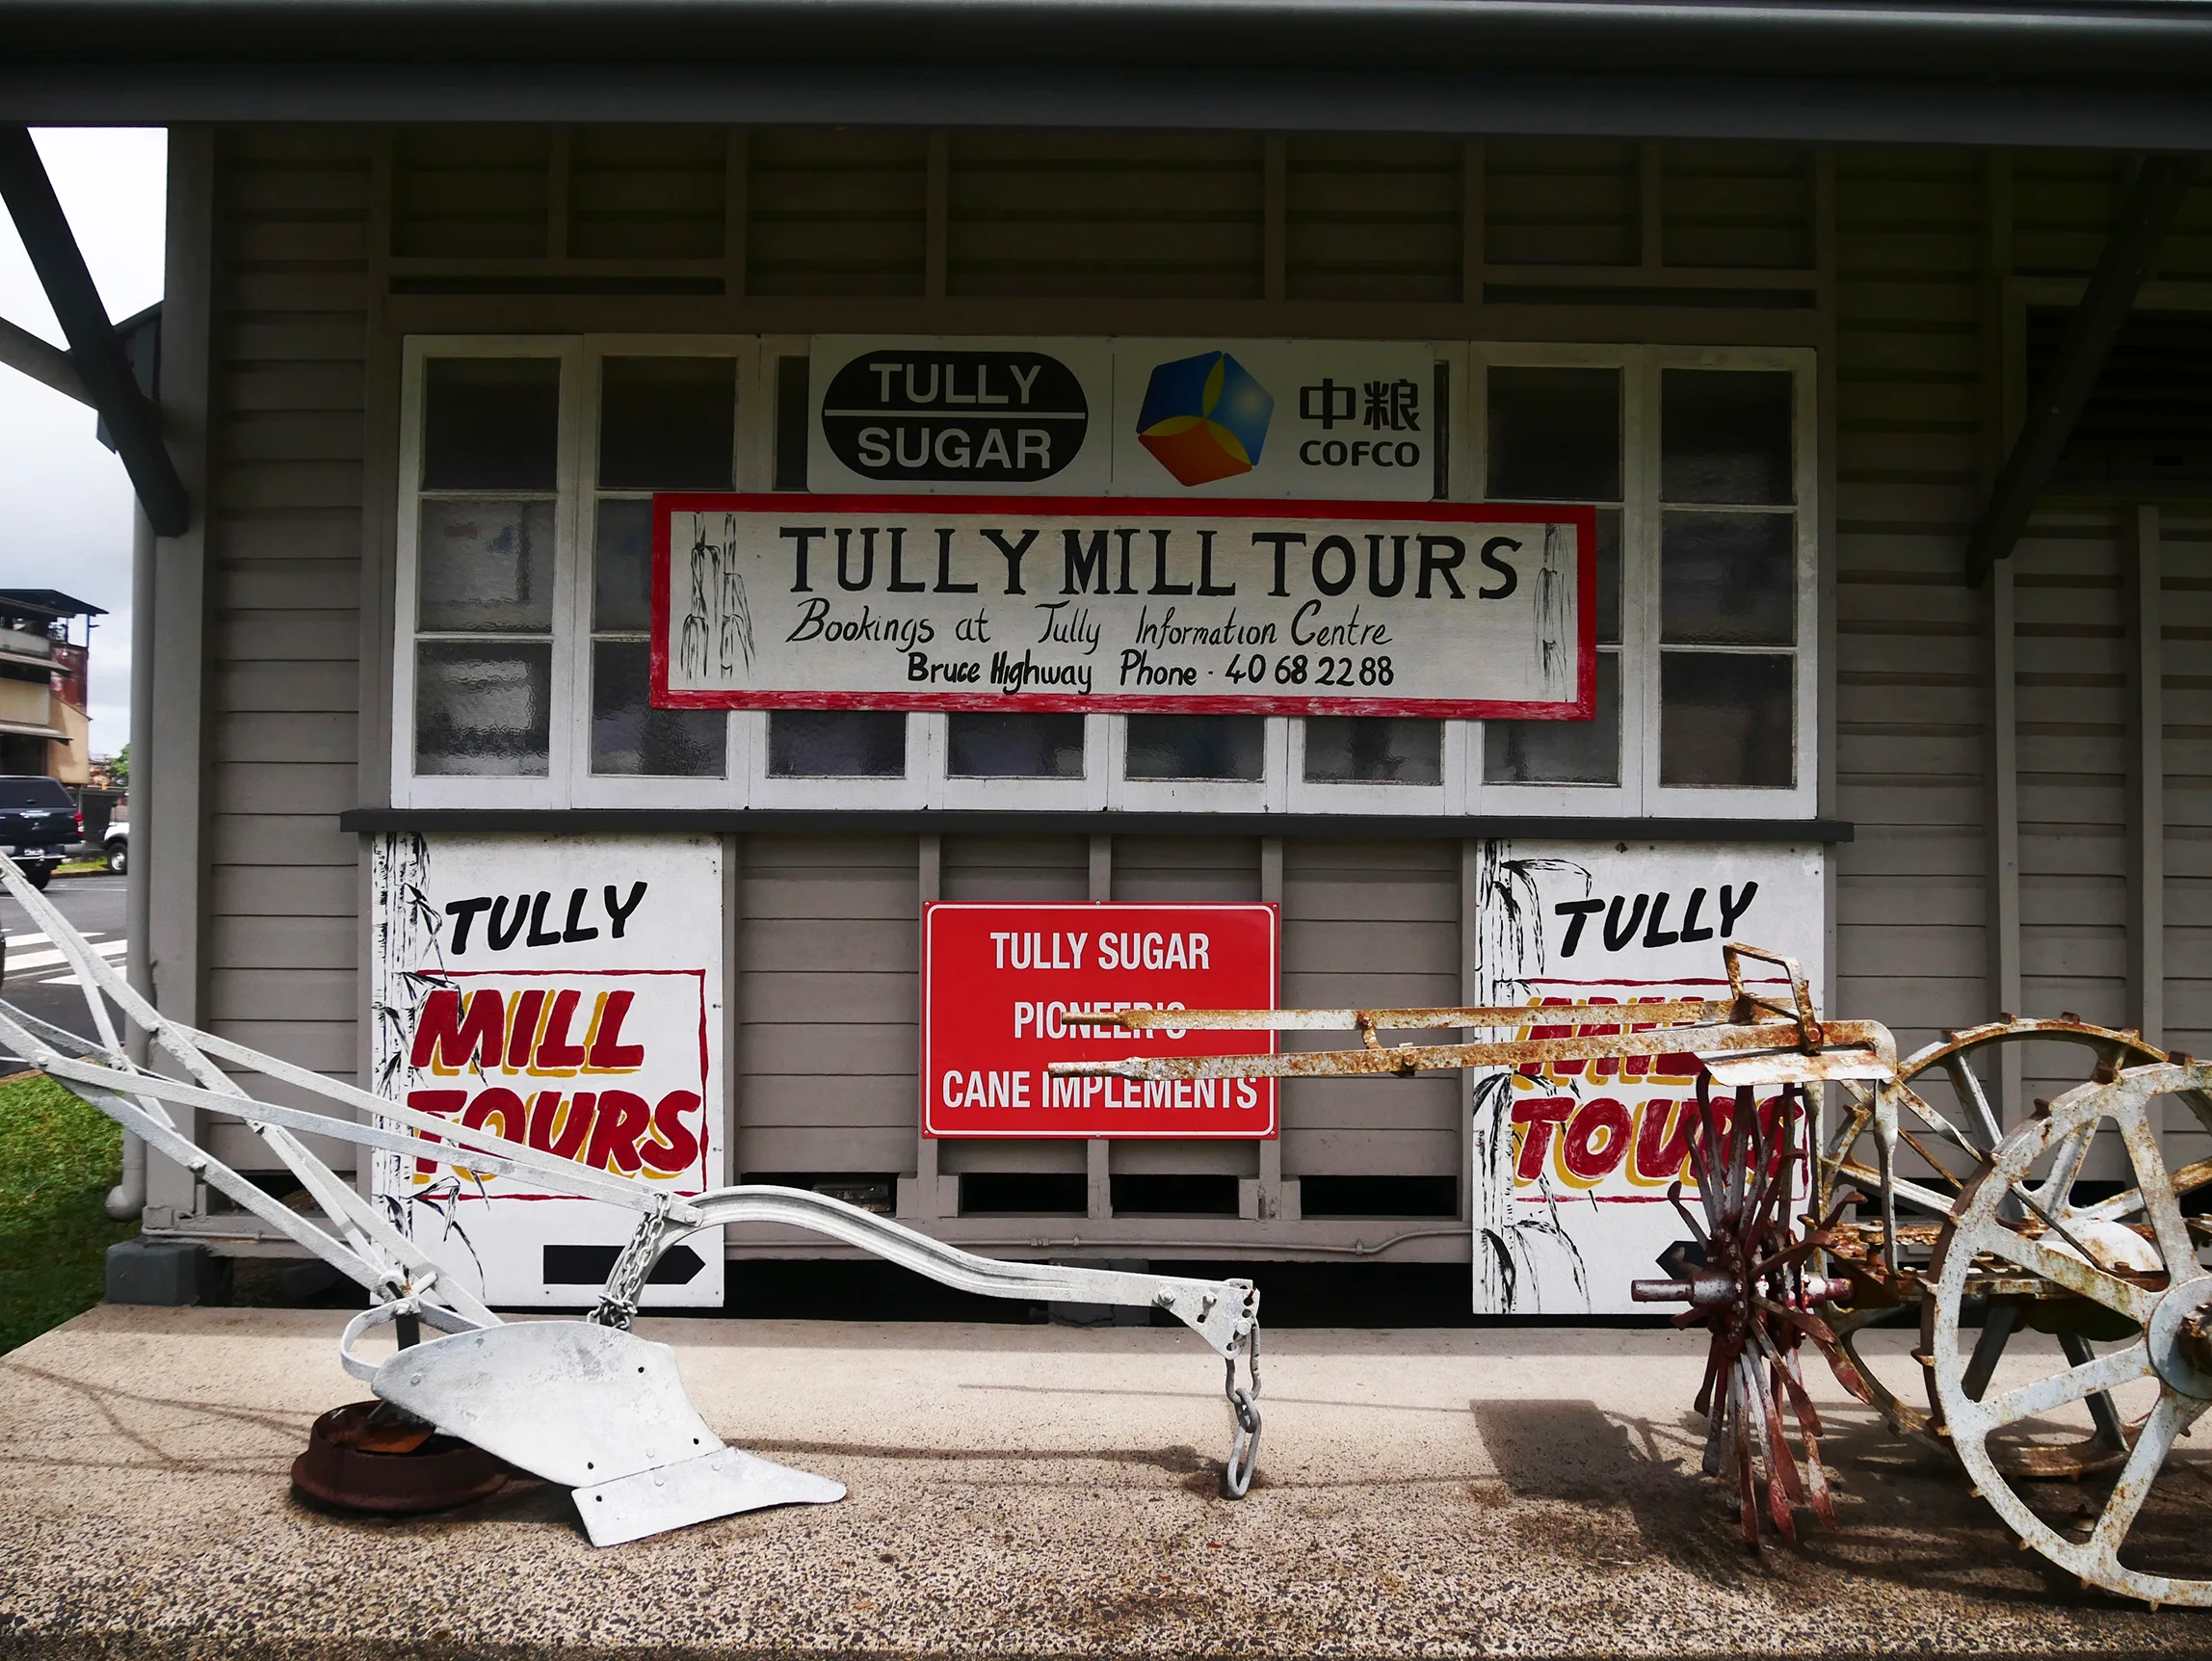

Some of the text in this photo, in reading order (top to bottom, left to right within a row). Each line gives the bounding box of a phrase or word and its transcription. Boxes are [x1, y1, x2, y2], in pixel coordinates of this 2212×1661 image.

[869, 363, 1041, 405] TULLY
[1299, 379, 1420, 432] 中粮
[858, 428, 1051, 470] SUGAR
[1299, 440, 1420, 468] COFCO
[779, 527, 1523, 599] TULLY MILL TOURS
[785, 597, 1393, 655] Bookings at Tully Information Centre
[908, 651, 981, 683] Bruce
[1120, 648, 1198, 686] Phone
[445, 881, 648, 956] TULLY
[1554, 881, 1758, 958] TULLY
[990, 932, 1210, 970] TULLY SUGAR
[409, 989, 645, 1076] MILL
[942, 1070, 1257, 1109] CANE IMPLEMENTS
[408, 1087, 702, 1175] TOURS
